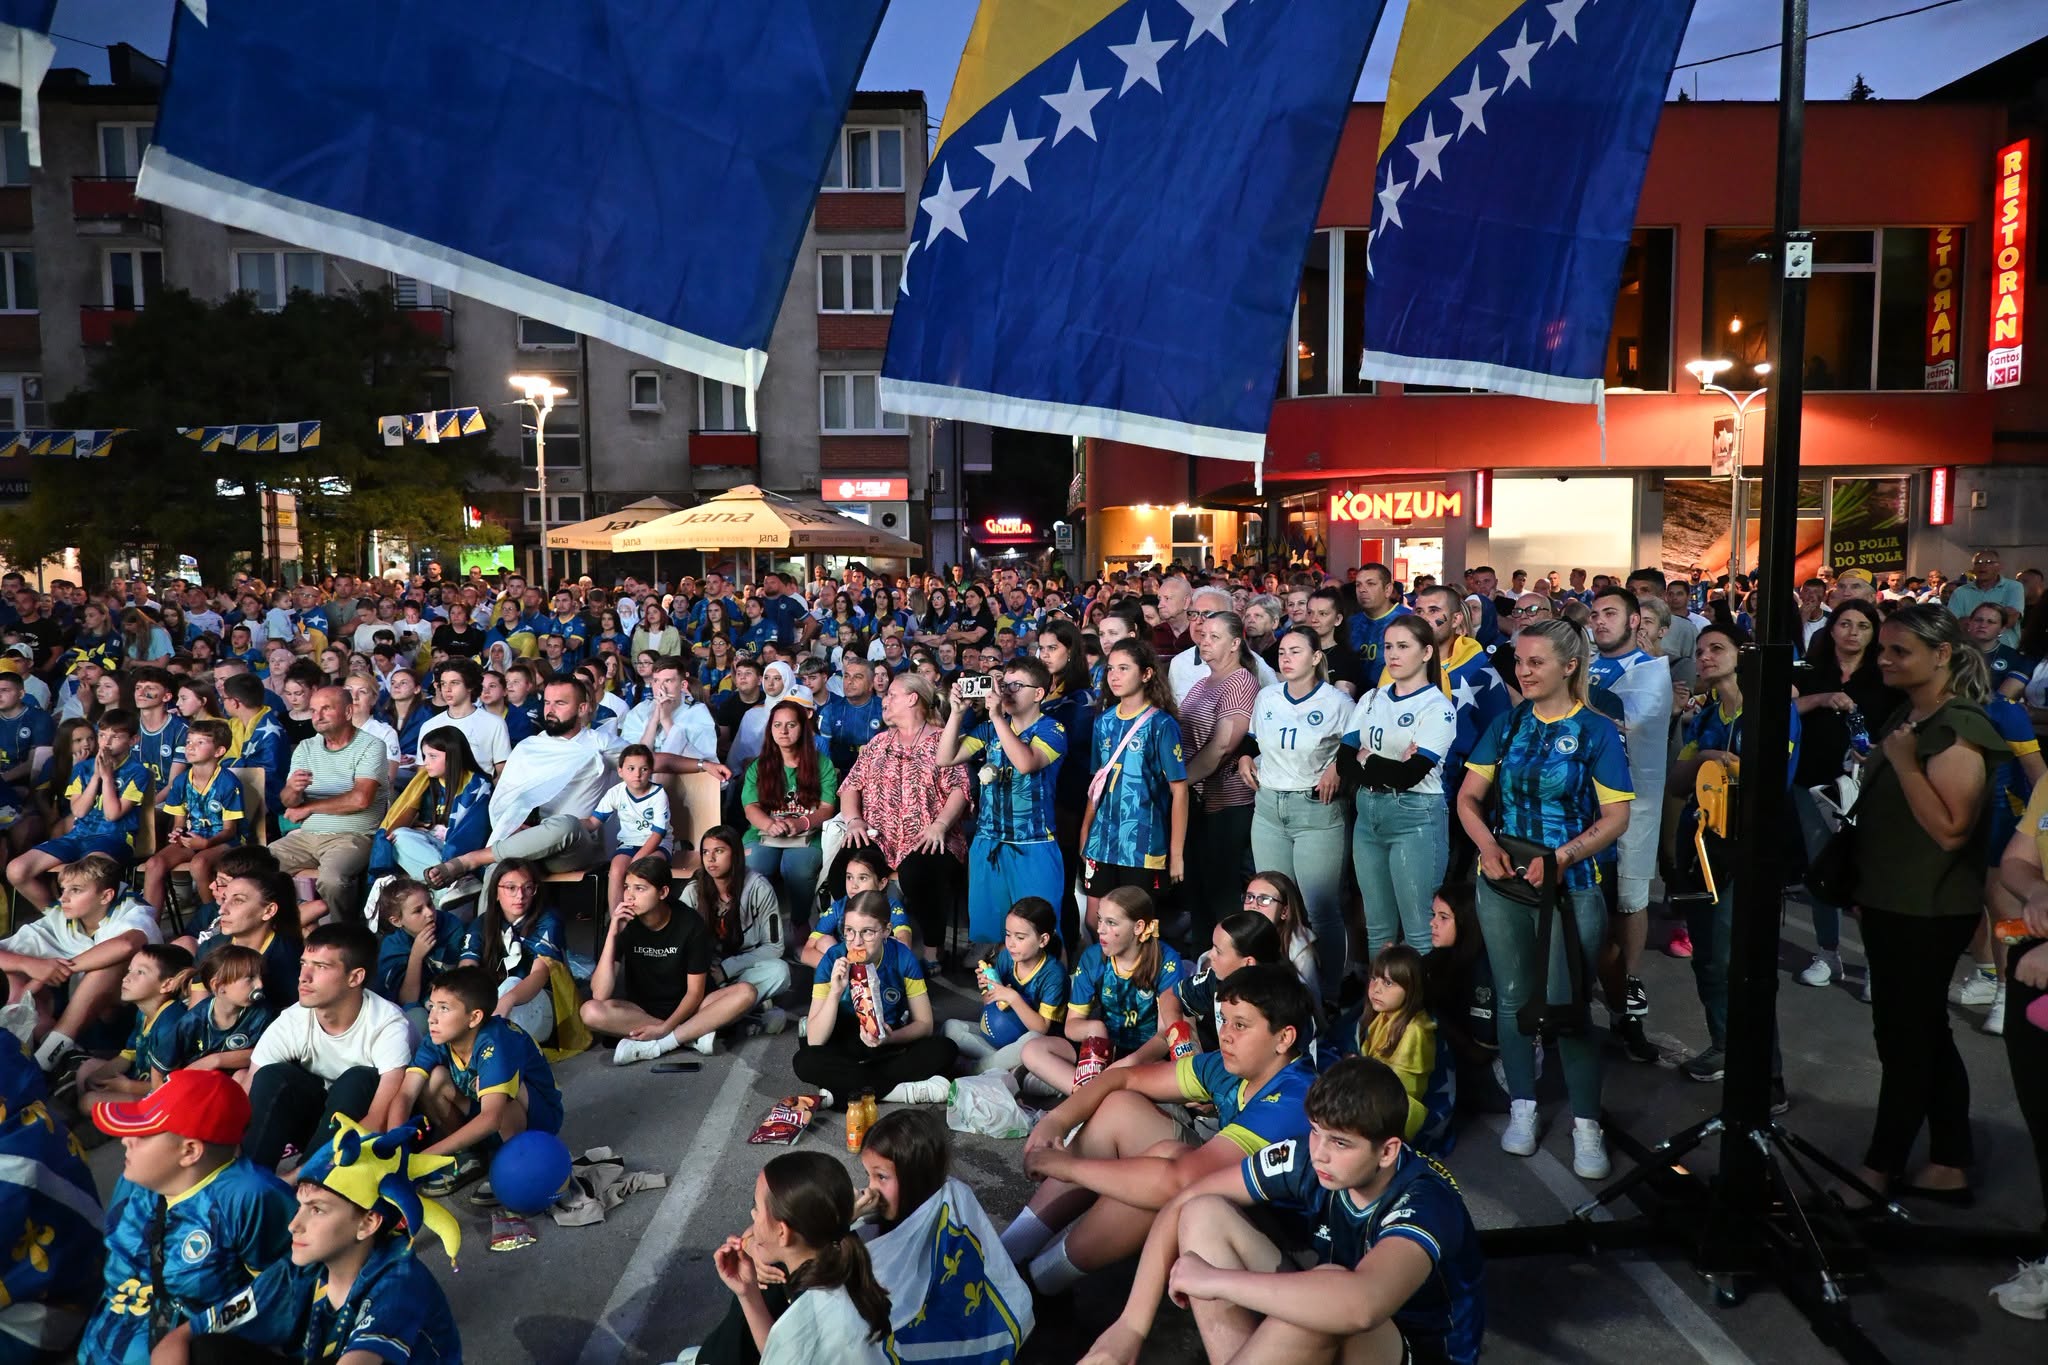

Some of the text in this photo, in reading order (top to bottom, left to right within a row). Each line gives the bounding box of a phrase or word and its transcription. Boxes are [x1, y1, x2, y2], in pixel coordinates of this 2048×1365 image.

[1995, 150, 2022, 342] RESTORAN
[1990, 353, 2019, 366] Santos
[1331, 490, 1461, 521] KONZUM
[1061, 528, 1067, 537] P
[1834, 541, 1855, 553] OD
[1835, 550, 1903, 568] DO STOLA
[1360, 643, 1378, 661] 20
[1279, 727, 1297, 750] 11
[1368, 725, 1384, 751] 19
[1109, 762, 1123, 793] 7
[635, 820, 650, 831] 20
[633, 945, 679, 955] LEGENDARY
